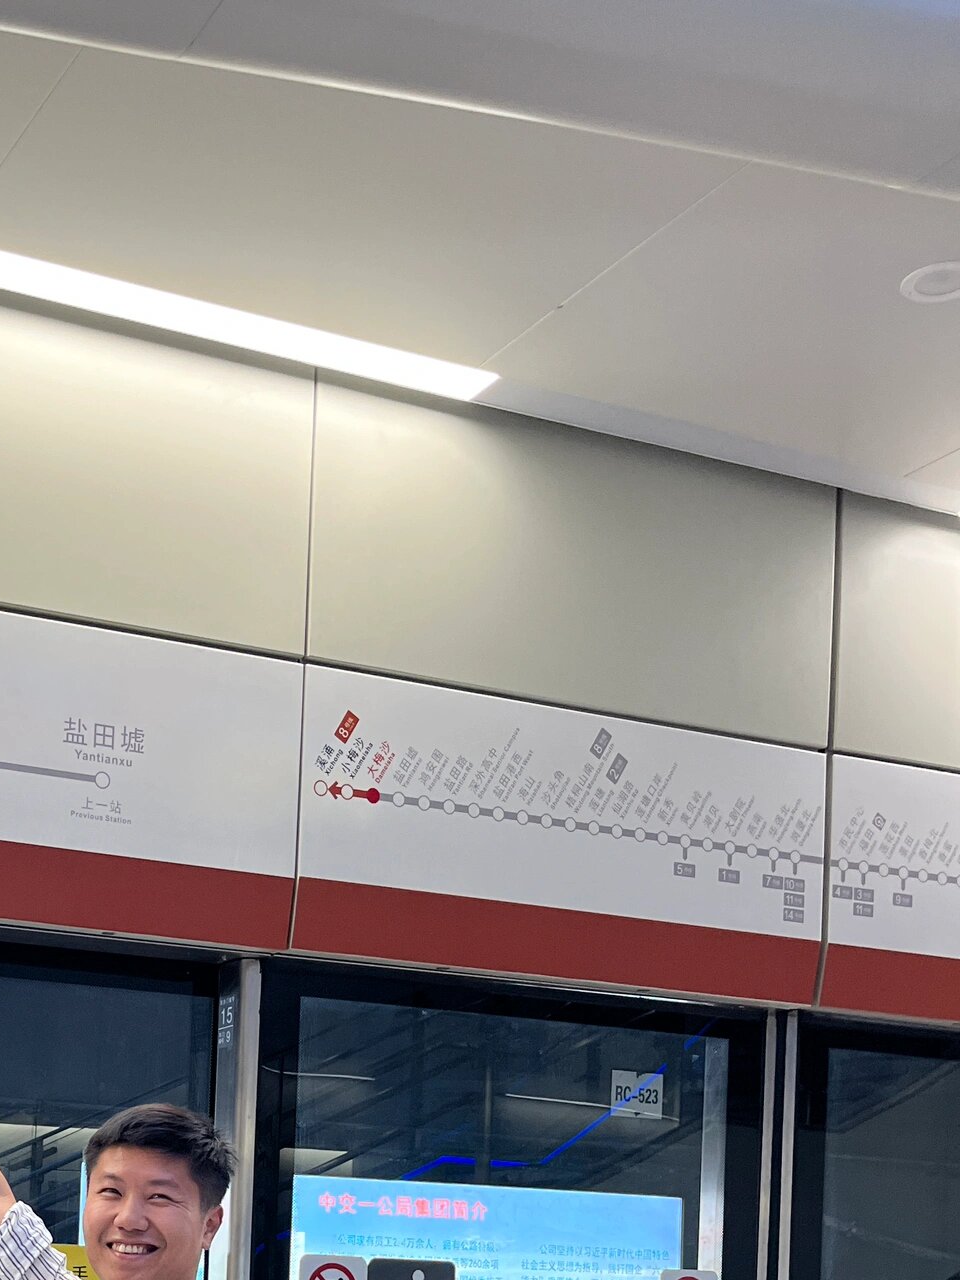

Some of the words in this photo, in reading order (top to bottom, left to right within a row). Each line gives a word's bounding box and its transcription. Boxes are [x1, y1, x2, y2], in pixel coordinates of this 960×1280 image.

[63, 717, 144, 754] 盐田墟
[339, 728, 349, 738] 8
[341, 737, 364, 773] 小梅沙
[593, 744, 602, 754] 8
[74, 750, 133, 767] Yantianxu
[325, 749, 343, 776] Xichong
[349, 742, 373, 779] Xiaomeisha
[367, 741, 390, 778] 大梅沙
[375, 752, 395, 784] Dameisha
[610, 768, 620, 780] 2
[82, 797, 122, 814] 上一站
[70, 810, 104, 822] Previous
[105, 814, 132, 825] Station
[221, 1006, 232, 1024] 15
[226, 1031, 230, 1042] 9
[615, 1086, 658, 1104] RC-523
[318, 1192, 488, 1221] 中交一公局集团简介
